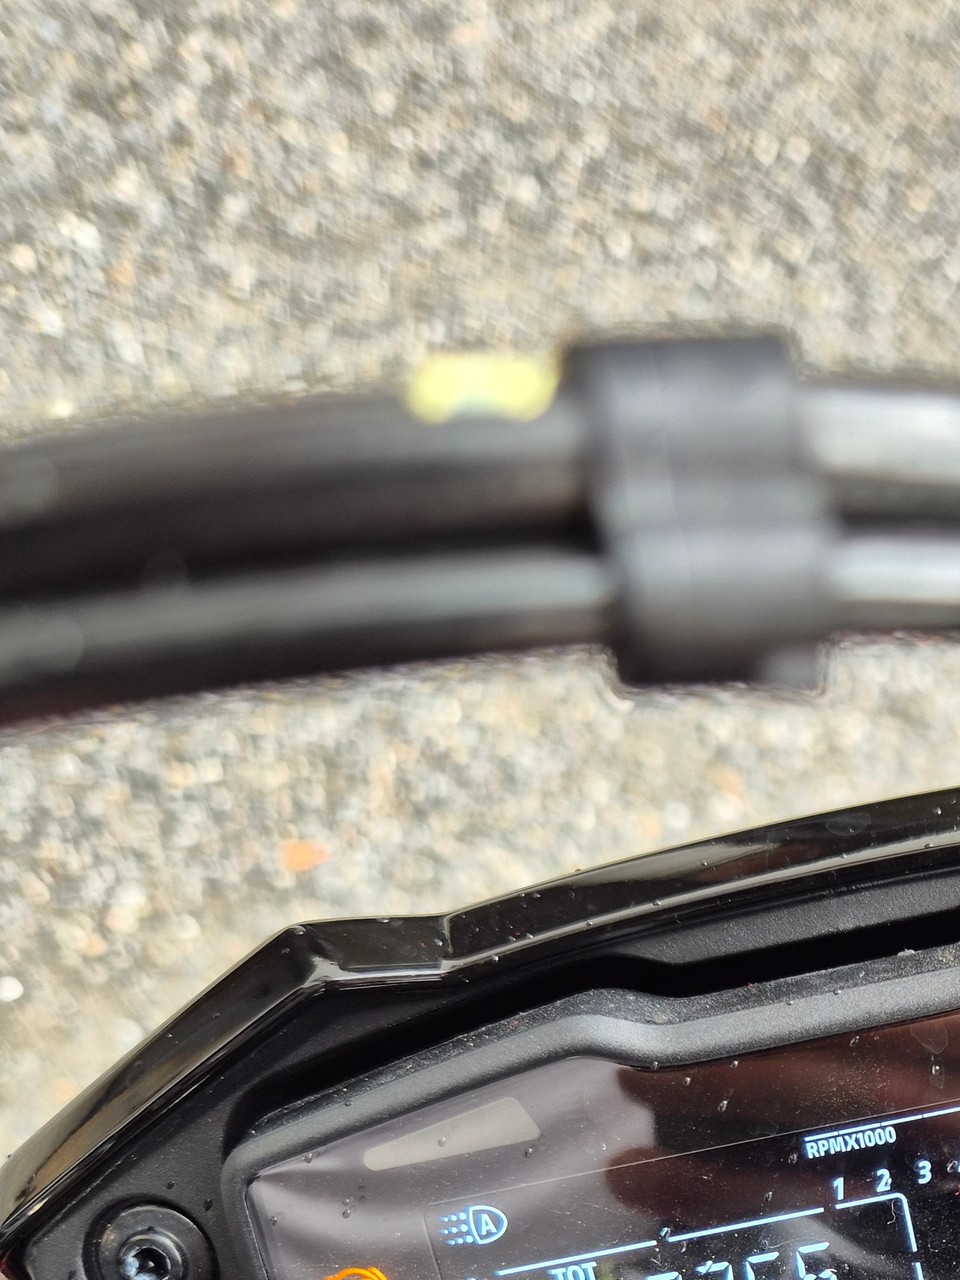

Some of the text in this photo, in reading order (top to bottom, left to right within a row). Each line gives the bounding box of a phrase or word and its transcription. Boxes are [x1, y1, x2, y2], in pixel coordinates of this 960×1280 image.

[805, 1126, 896, 1160] RPMX1000
[833, 1177, 845, 1200] 1
[876, 1169, 893, 1192] 2
[917, 1160, 932, 1184] 3
[481, 1213, 497, 1236] A
